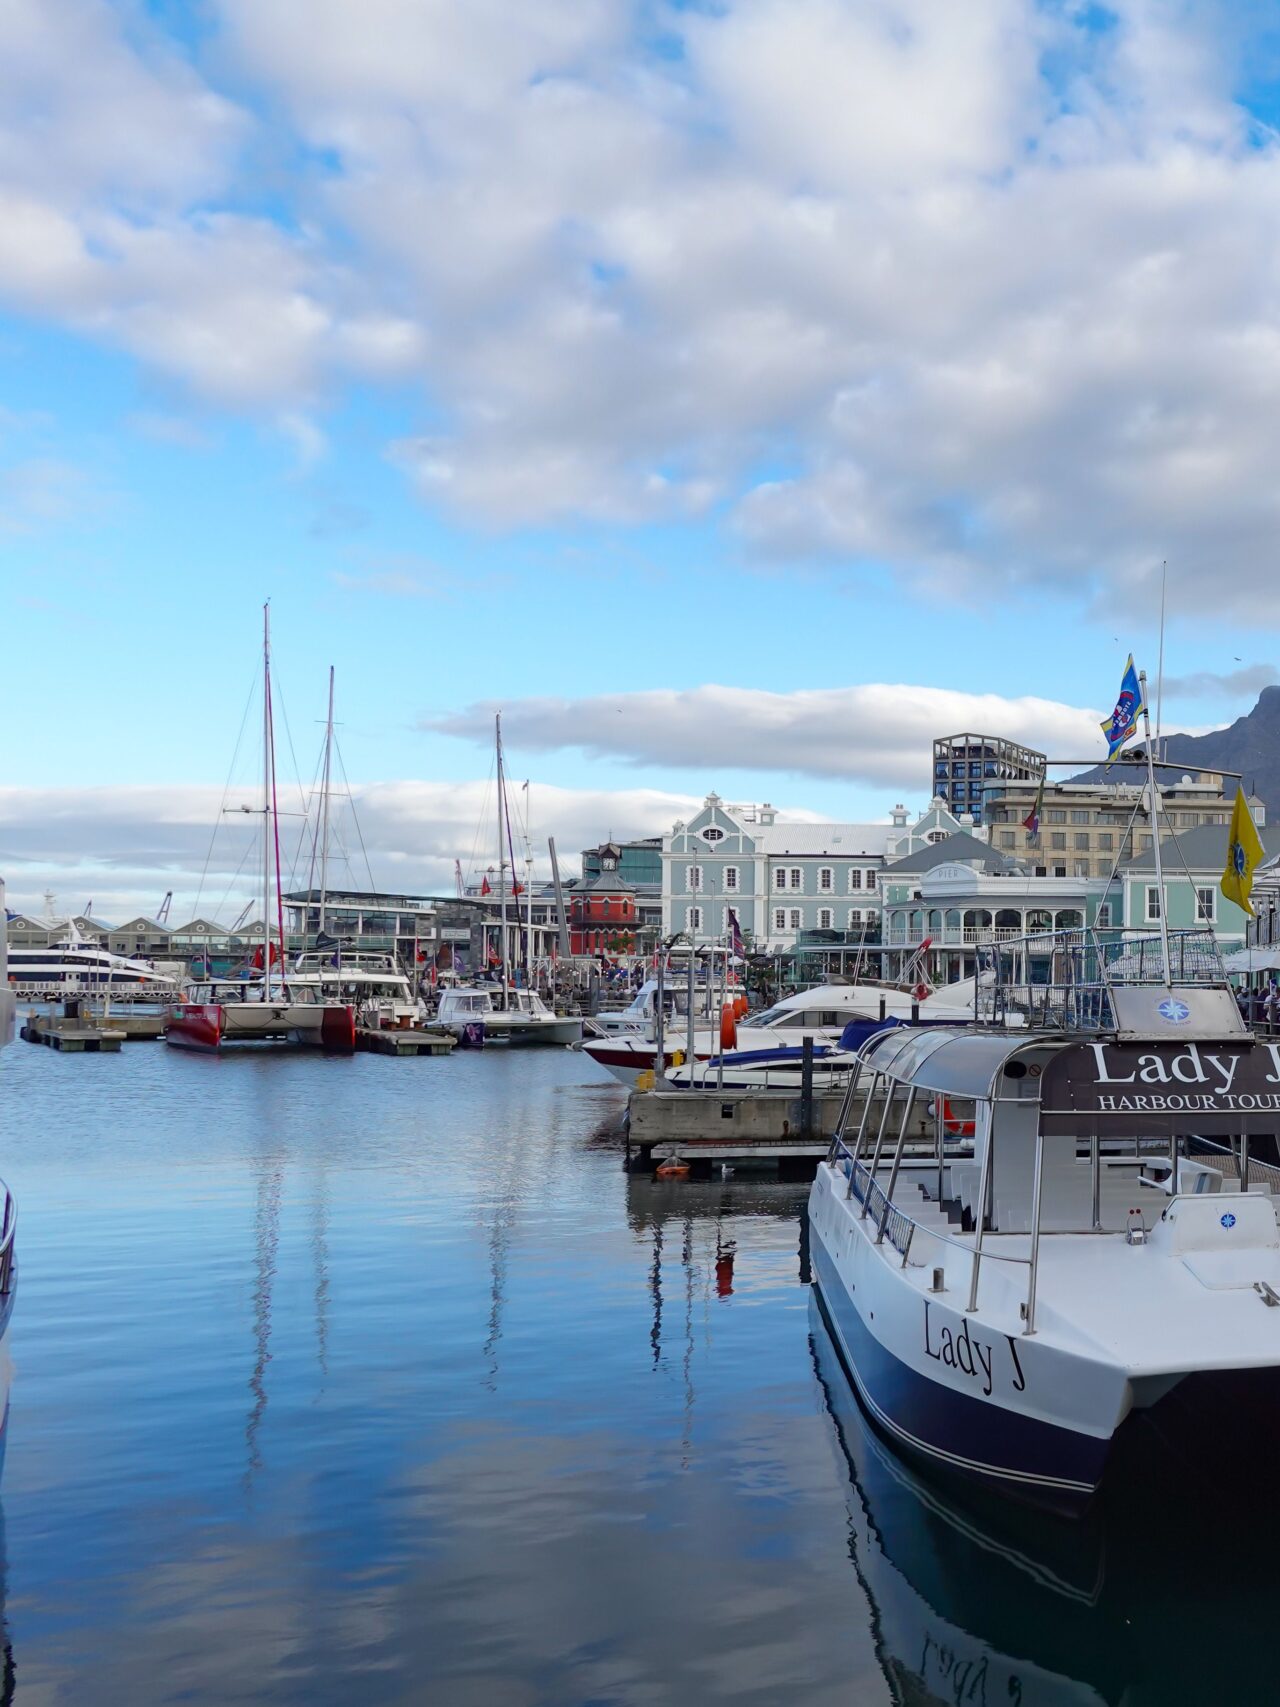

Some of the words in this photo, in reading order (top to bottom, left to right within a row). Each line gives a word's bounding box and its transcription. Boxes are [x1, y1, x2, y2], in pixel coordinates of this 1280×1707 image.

[1086, 1043, 1241, 1095] Lady
[1097, 1094, 1219, 1110] HARBOUR
[923, 1299, 993, 1396] Lady
[1003, 1334, 1026, 1392] J
